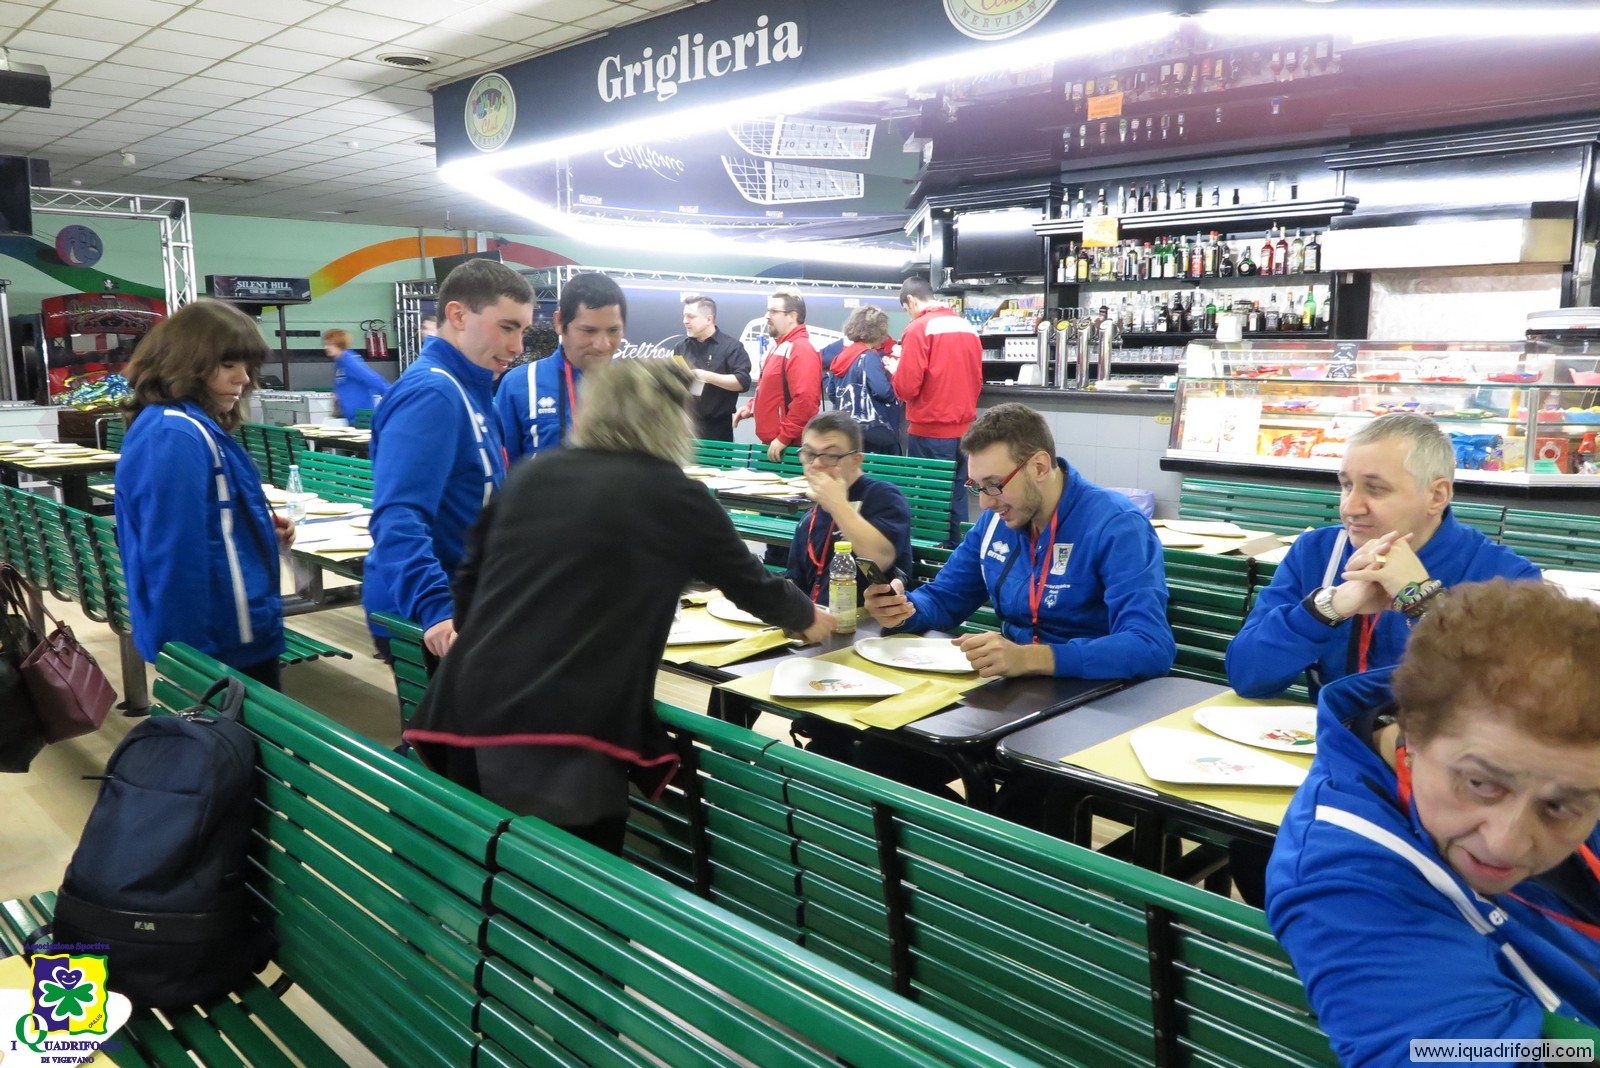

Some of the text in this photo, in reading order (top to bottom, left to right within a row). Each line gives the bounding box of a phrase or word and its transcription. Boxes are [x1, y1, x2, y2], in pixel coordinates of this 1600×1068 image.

[961, 1, 1037, 28] NERVIAN
[597, 15, 802, 102] Griglieria
[236, 281, 291, 289] SILENT HILL
[612, 339, 675, 360] Steltron
